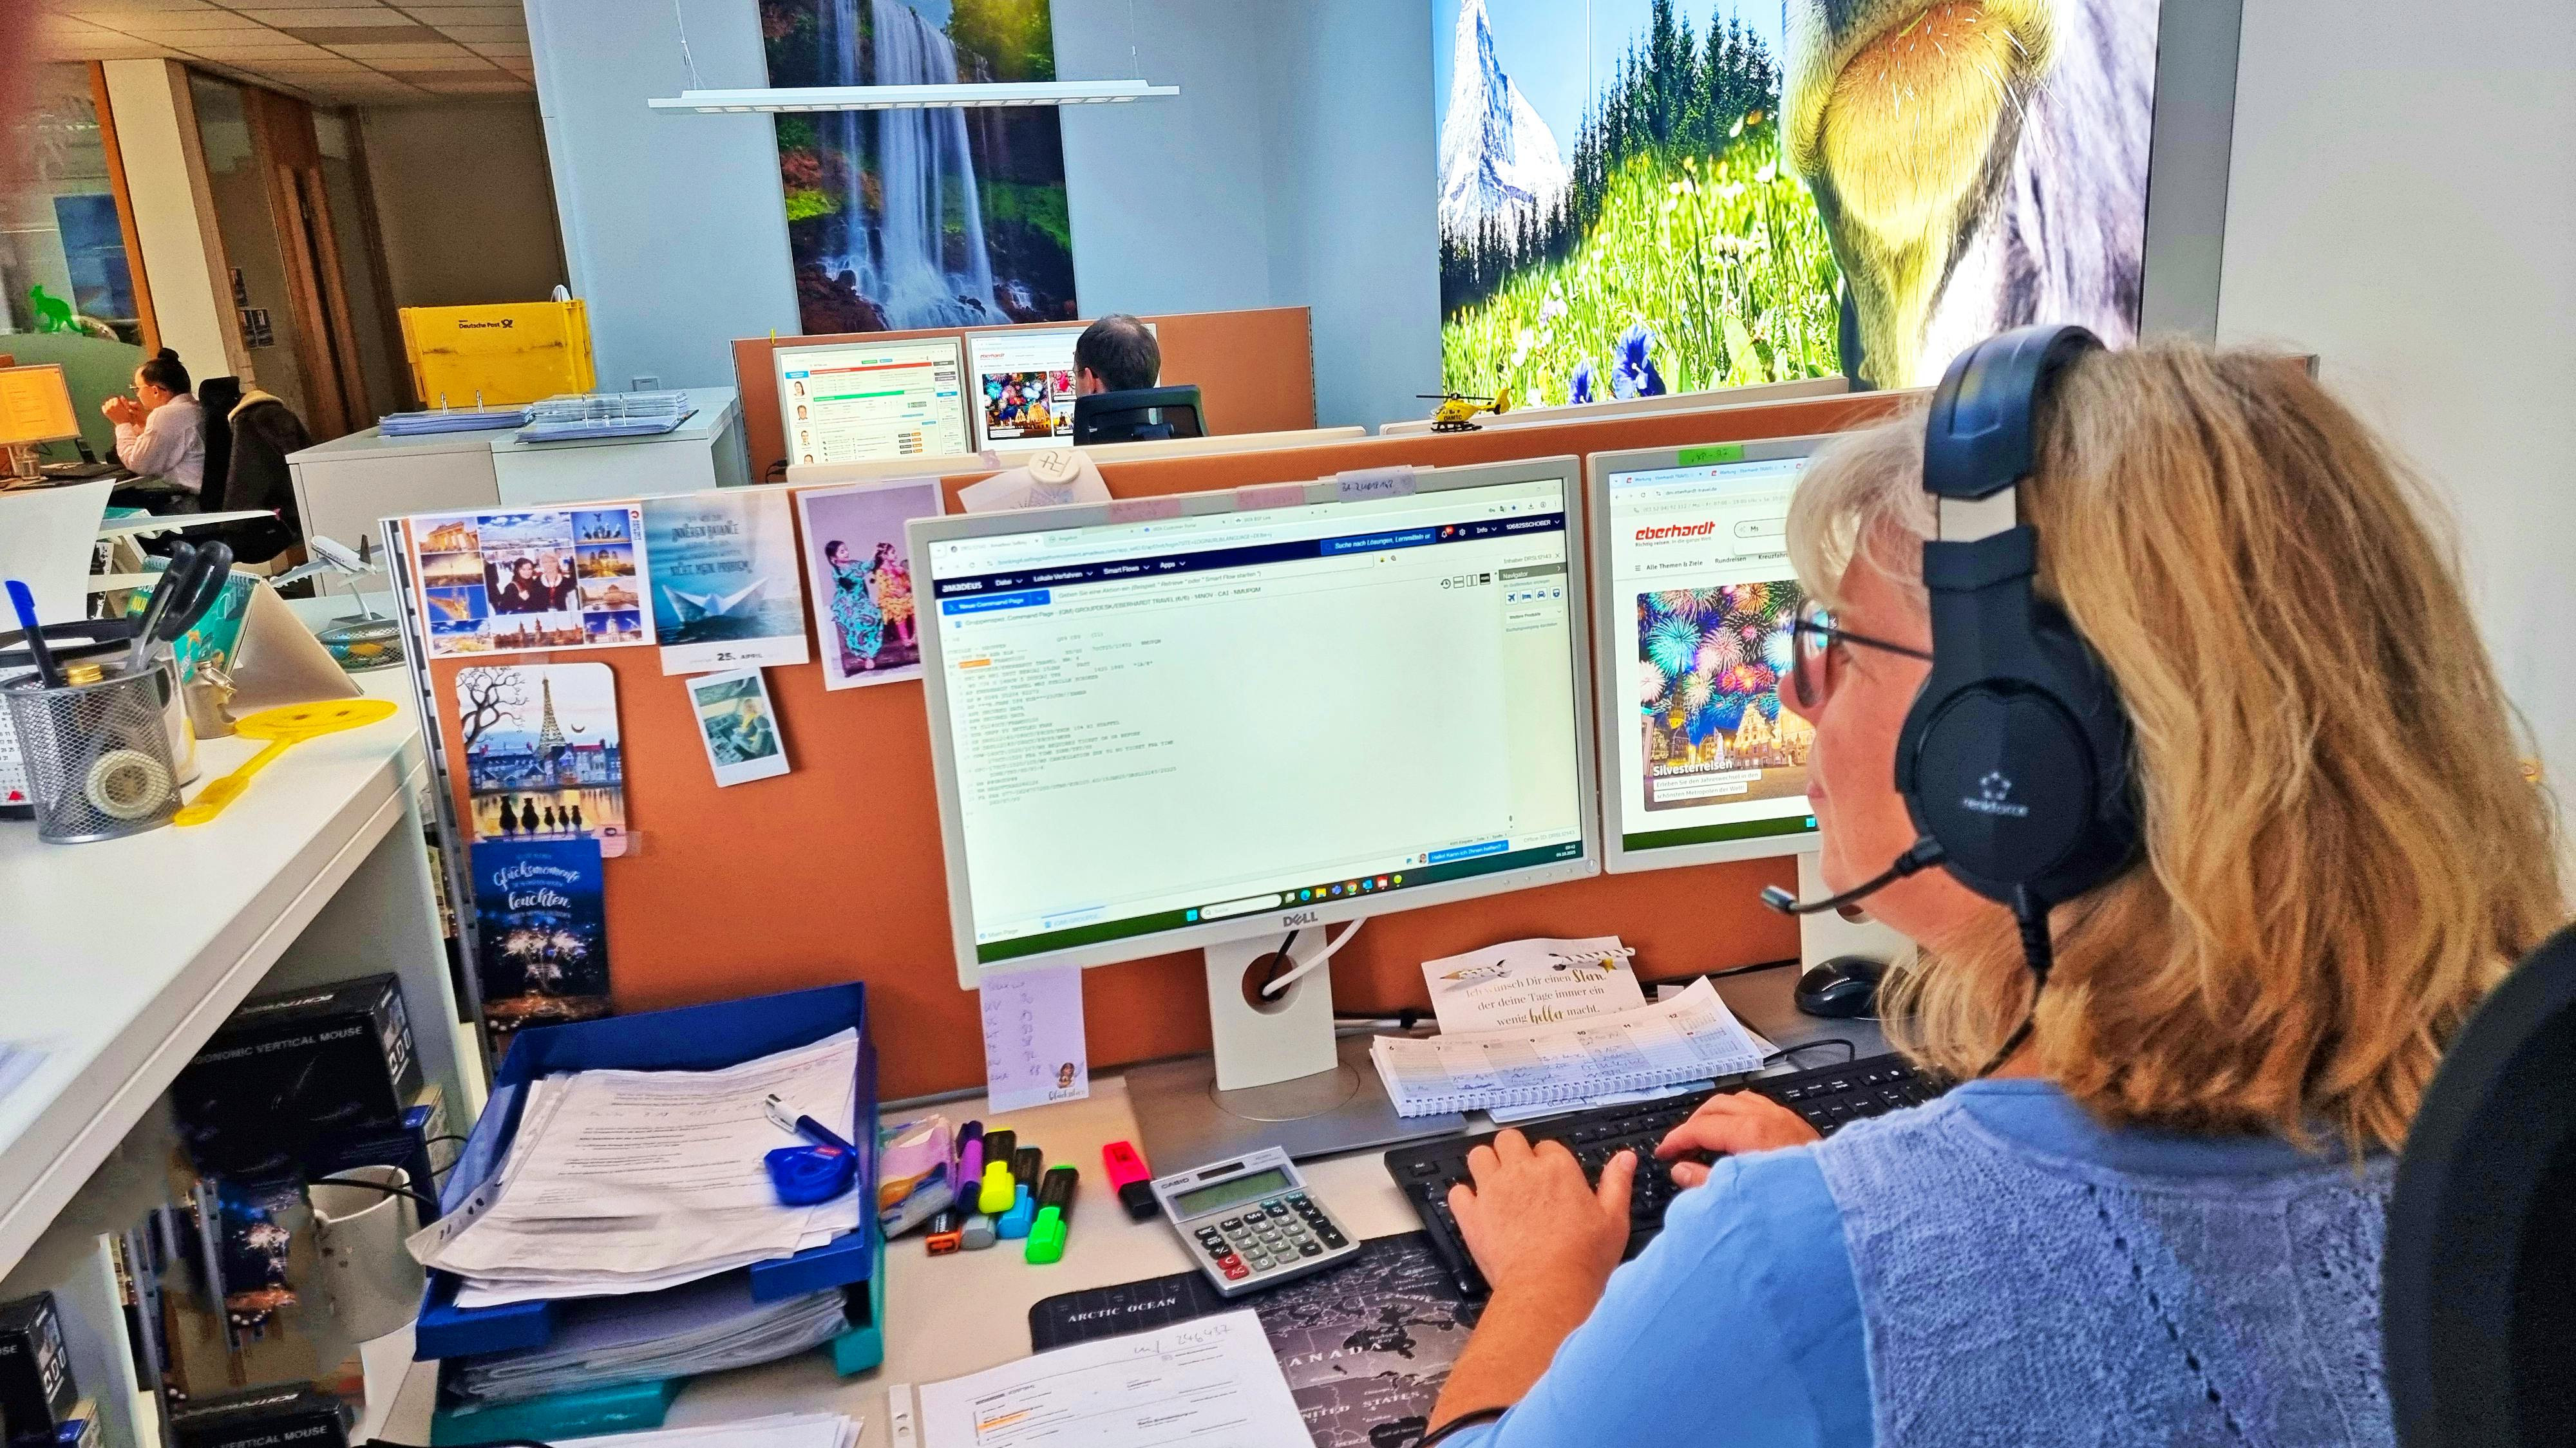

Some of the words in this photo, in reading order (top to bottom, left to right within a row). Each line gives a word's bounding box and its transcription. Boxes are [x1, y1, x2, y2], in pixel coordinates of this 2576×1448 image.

[1635, 521, 1716, 541] eberhardt
[1367, 538, 1394, 547] Lösungen,
[1715, 556, 1747, 564] Rundreisen
[1054, 571, 1083, 580] Verfahren
[1103, 567, 1122, 575] Smart
[1122, 565, 1140, 573] Flows
[1502, 571, 1529, 579] Navigator
[976, 599, 1008, 608] Command
[1008, 597, 1025, 605] Page
[1007, 612, 1039, 621] Command
[1039, 610, 1054, 619] Page
[717, 652, 736, 661] 25.
[1653, 759, 1733, 776] Silvesterreisen
[1656, 779, 1678, 788] Erleben
[1700, 773, 1740, 784] Jahreswechsel
[1656, 790, 1685, 799] schönsten
[1686, 787, 1718, 797] Metropolen
[1283, 912, 1318, 927] DELL
[1526, 975, 1542, 986] Dir
[1544, 975, 1572, 984] einen
[1477, 999, 1495, 1011] der
[1497, 995, 1526, 1008] deine
[1528, 992, 1553, 1003] Tage
[1555, 986, 1587, 999] immer
[1589, 986, 1605, 996] ein
[1496, 1013, 1528, 1027] wenig
[1529, 1004, 1564, 1025] heller
[1566, 1003, 1601, 1017] macht.
[256, 1035, 316, 1054] VERTICAL
[319, 1025, 363, 1042] MOUSE
[1161, 1177, 1190, 1190] CASIO
[1260, 1258, 1269, 1266] 0
[1231, 1267, 1245, 1276] AC
[1067, 1307, 1122, 1324] ARCTIC
[1126, 1297, 1177, 1314] OCEAN
[1361, 1391, 1420, 1409] STATES
[1301, 1405, 1350, 1420] NITED
[283, 1425, 328, 1442] MOUSE
